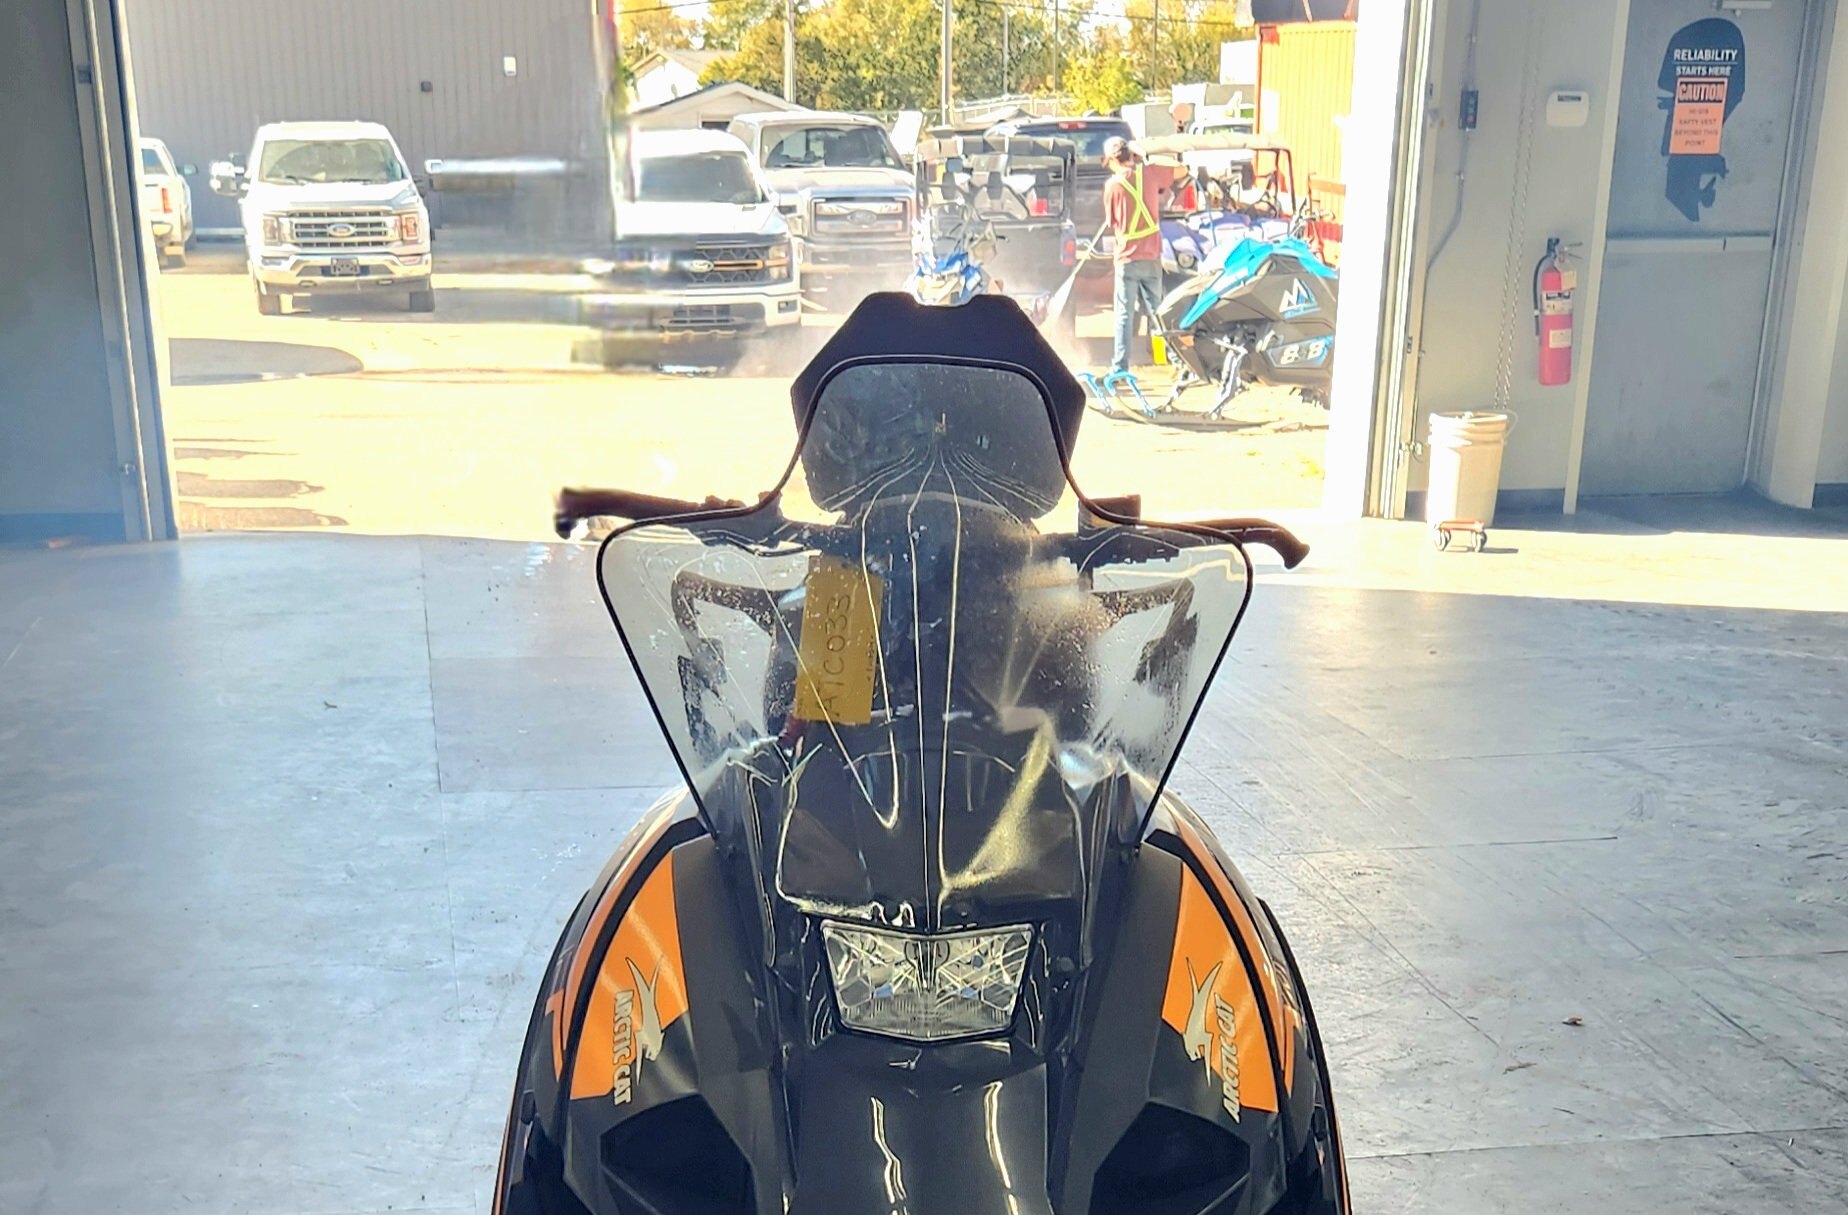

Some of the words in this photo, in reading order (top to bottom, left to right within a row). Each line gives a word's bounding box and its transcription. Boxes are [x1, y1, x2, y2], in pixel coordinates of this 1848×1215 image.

[1674, 49, 1738, 61] RELIABILITY
[1676, 65, 1707, 76] STARTS
[1708, 65, 1732, 76] HERE
[1678, 82, 1725, 101] CAUTION
[613, 989, 635, 1065] ARCTIC
[1213, 991, 1236, 1039] CAT
[613, 1063, 633, 1105] CAT
[1219, 1034, 1241, 1124] ARCTIC
